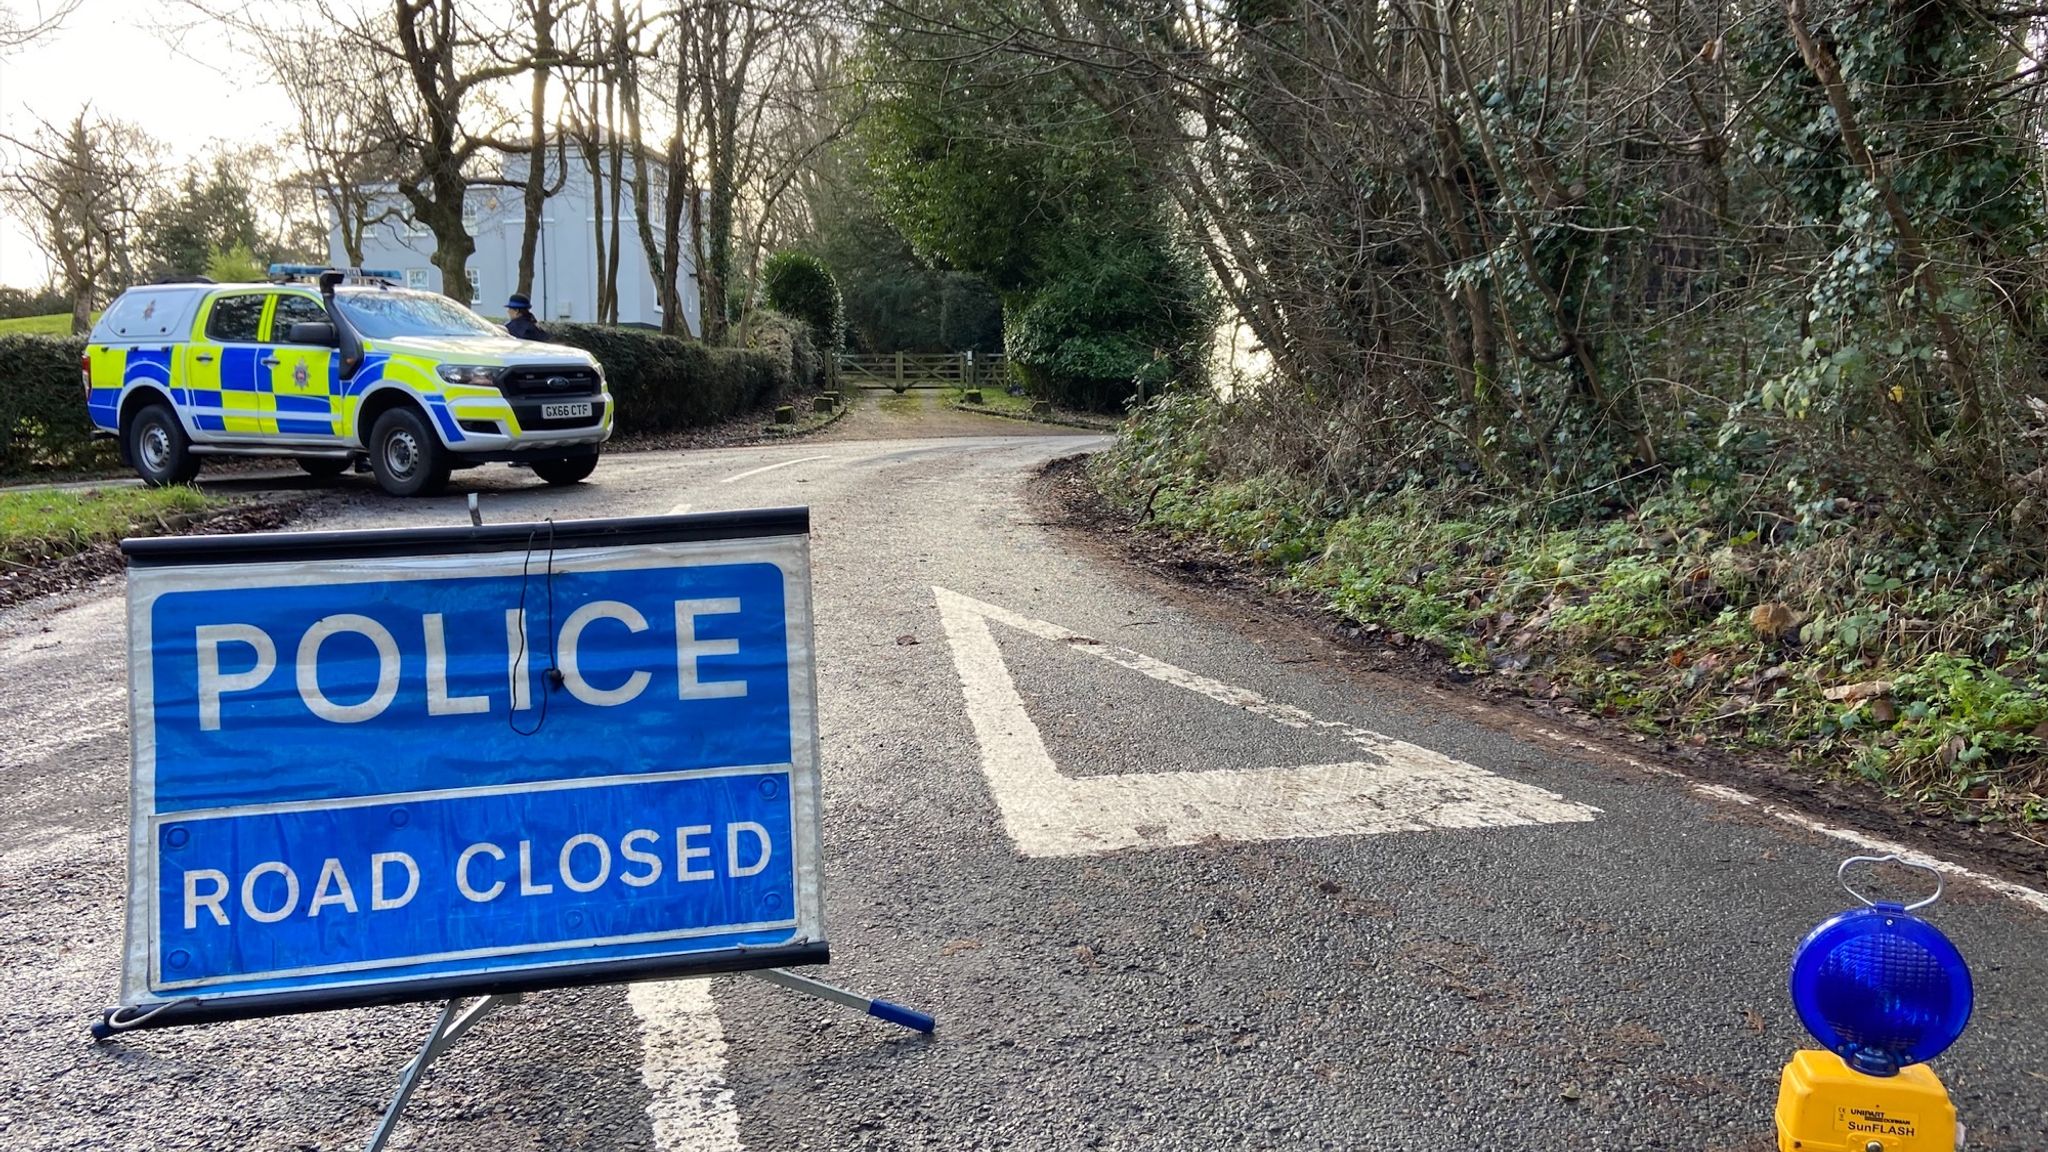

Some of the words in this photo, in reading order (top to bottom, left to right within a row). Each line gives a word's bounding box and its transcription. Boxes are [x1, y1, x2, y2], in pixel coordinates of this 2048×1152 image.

[546, 406, 570, 417] GX66
[571, 404, 588, 416] CTF
[195, 596, 748, 732] POLICE
[183, 851, 421, 930] ROAD
[456, 821, 773, 904] CLOSED
[1850, 1108, 1885, 1119] UNIPART
[1848, 1121, 1915, 1136] SunFLASH
